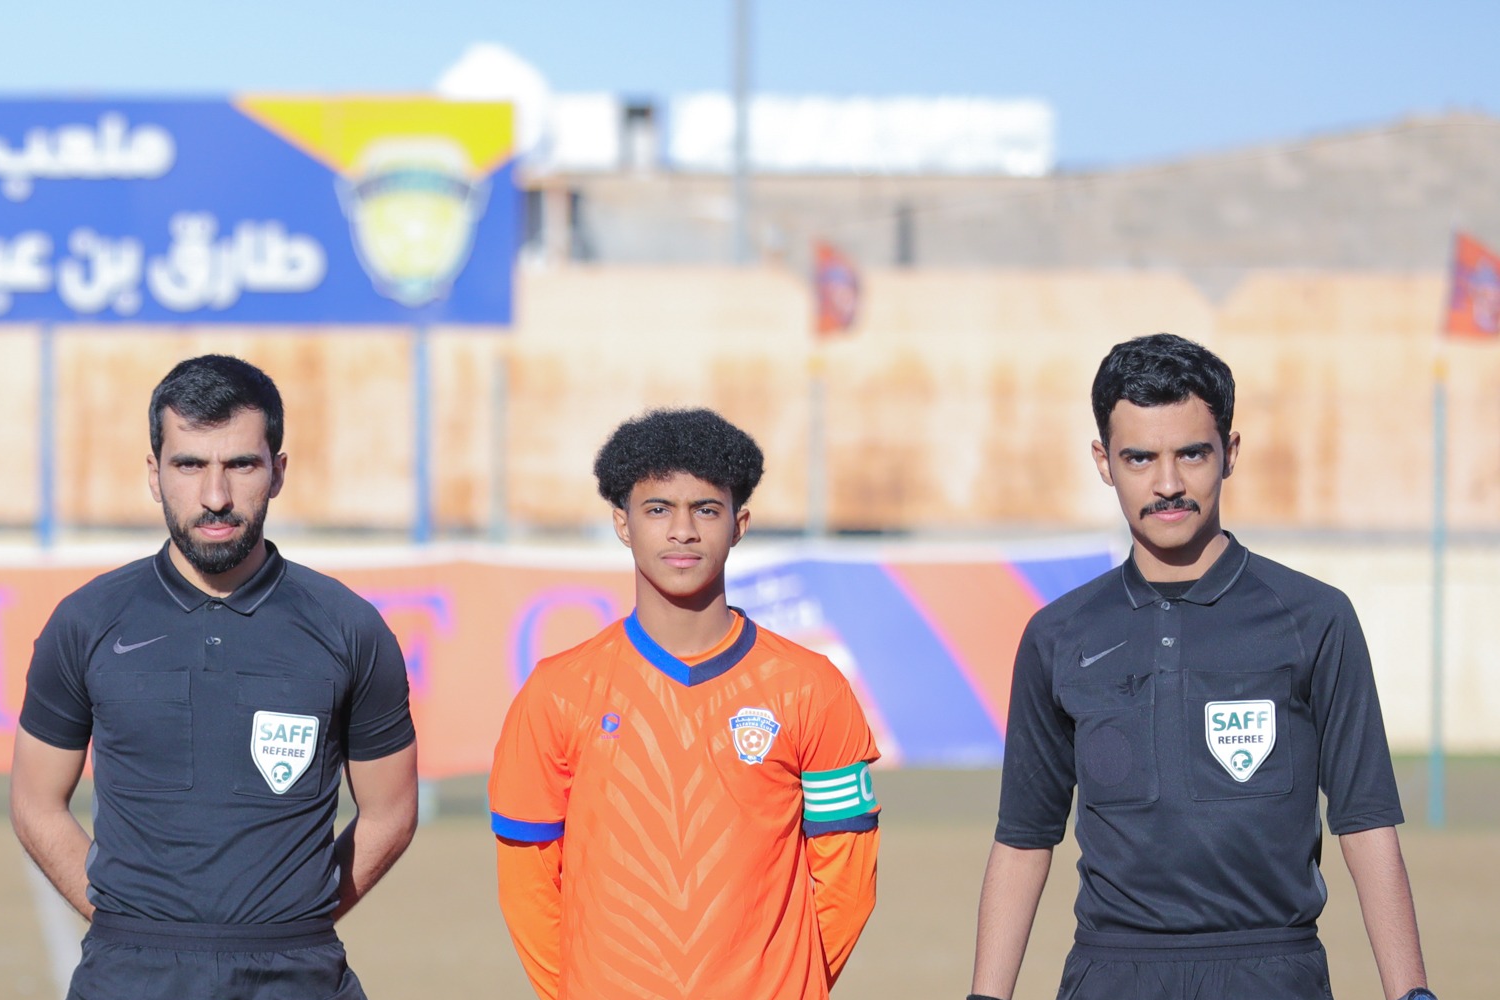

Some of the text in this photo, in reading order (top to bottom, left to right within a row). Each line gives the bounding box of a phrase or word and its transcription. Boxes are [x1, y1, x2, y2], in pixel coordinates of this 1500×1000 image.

[57, 227, 153, 316] بن
[147, 211, 327, 312] طارق
[1212, 711, 1268, 731] SAFF
[260, 723, 313, 744] SAFF
[1218, 735, 1264, 745] REFEREE
[262, 746, 306, 758] REFEREE
